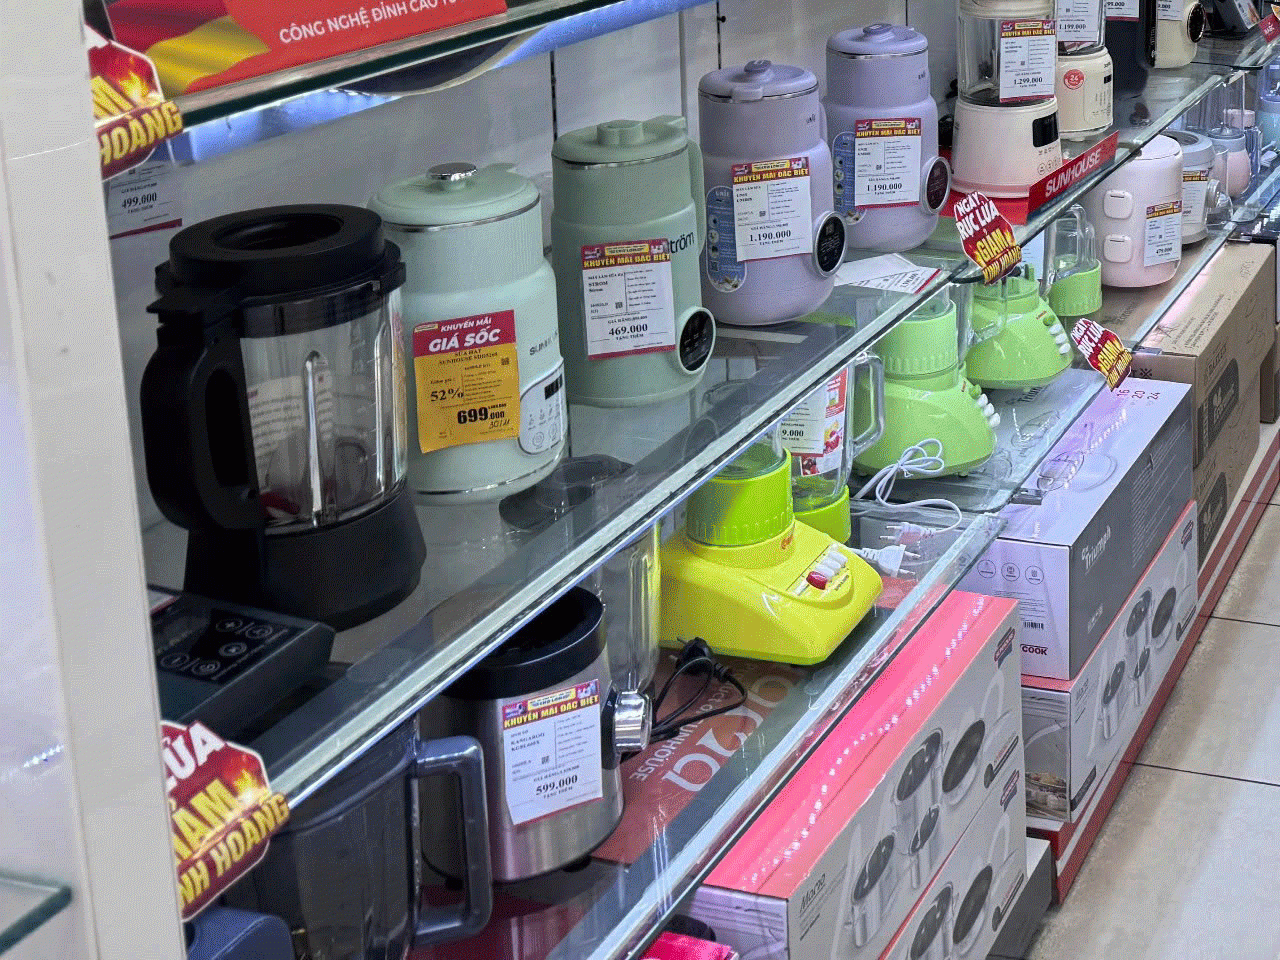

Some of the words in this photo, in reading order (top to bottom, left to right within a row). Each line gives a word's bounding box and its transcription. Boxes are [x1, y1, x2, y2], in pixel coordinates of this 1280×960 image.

[279, 21, 325, 44] CÔNG
[328, 6, 370, 32] NGHỆ
[372, 0, 408, 22] ĐỈNH
[1014, 77, 1043, 85] 1.299.000
[1046, 149, 1102, 197] SUNHOUSE
[867, 182, 903, 192] 1.190.000
[122, 192, 157, 209] 499.000
[670, 232, 694, 254] tröm
[750, 230, 792, 242] 1.190.000
[441, 318, 474, 332] KHUYẾN
[476, 316, 492, 326] MÃI
[609, 323, 648, 336] 469.000
[428, 332, 459, 353] GIÁ
[464, 325, 501, 346] SỐC
[430, 388, 464, 402] 52%
[1117, 389, 1130, 397] 16
[1132, 390, 1146, 399] 20
[1147, 392, 1161, 400] 24
[536, 774, 578, 795] 599.000
[210, 793, 290, 879] HOÀNG
